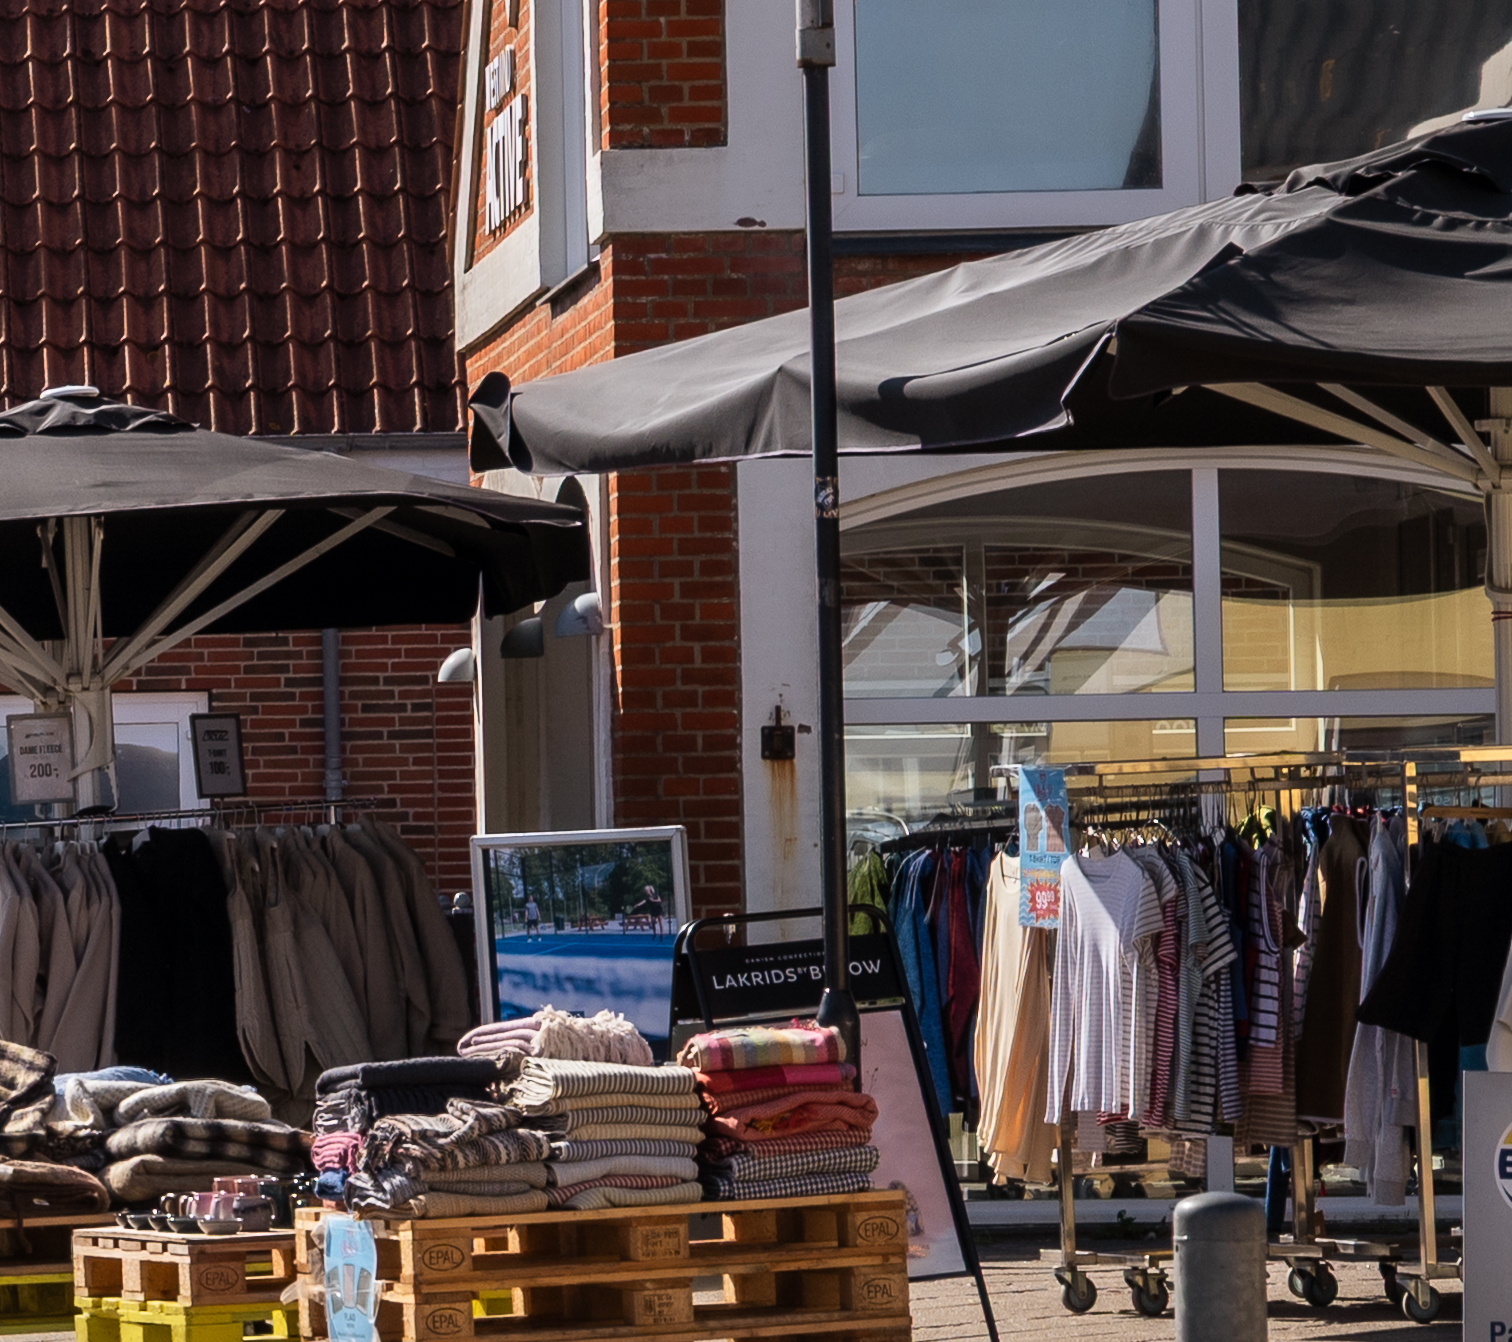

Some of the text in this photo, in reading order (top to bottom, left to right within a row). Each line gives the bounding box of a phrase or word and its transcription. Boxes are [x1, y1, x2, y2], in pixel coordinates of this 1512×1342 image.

[485, 93, 524, 236] ACTIVE
[712, 968, 797, 990] LAKRIDS
[865, 1222, 894, 1238] EPAL
[429, 1250, 458, 1266] EPAL
[205, 1274, 231, 1286] EPAL
[867, 1283, 896, 1300] EPAL
[432, 1314, 461, 1330] EPAL
